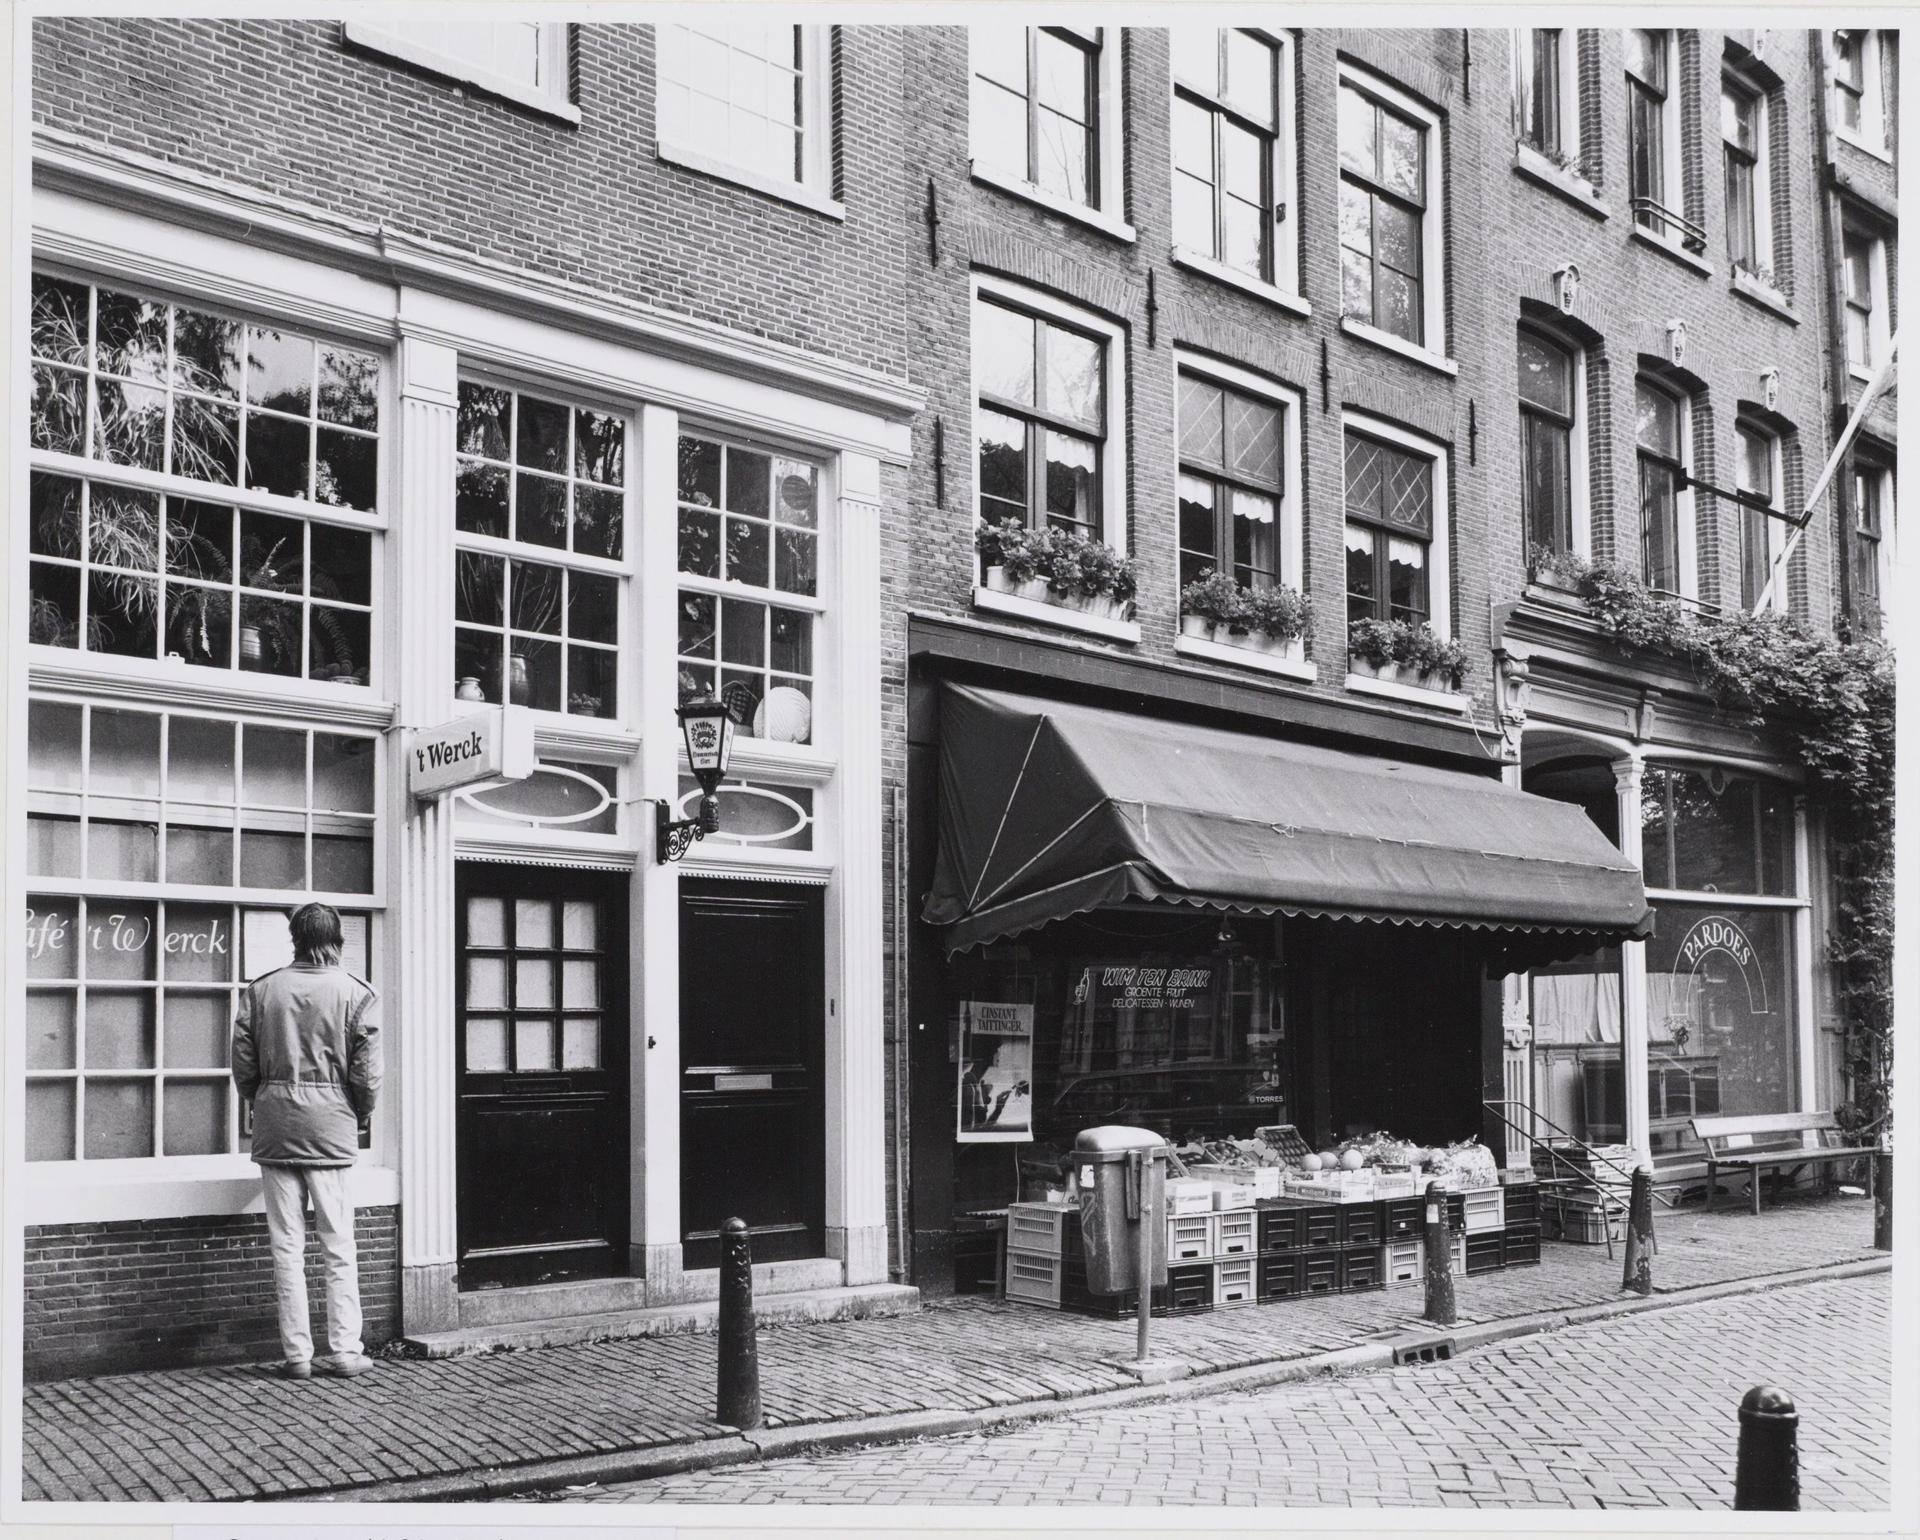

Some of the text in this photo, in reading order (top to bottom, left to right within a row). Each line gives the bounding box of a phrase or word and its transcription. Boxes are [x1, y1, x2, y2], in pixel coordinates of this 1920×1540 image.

[427, 731, 482, 769] Werck
[108, 914, 227, 954] Werck
[1684, 922, 1751, 965] PARDOES
[1102, 967, 1211, 988] WIM TEN BRINK
[1124, 986, 1187, 998] GROENTE FRUIT
[1112, 998, 1163, 1009] DELICATESSEN
[1255, 1095, 1284, 1104] TORRES
